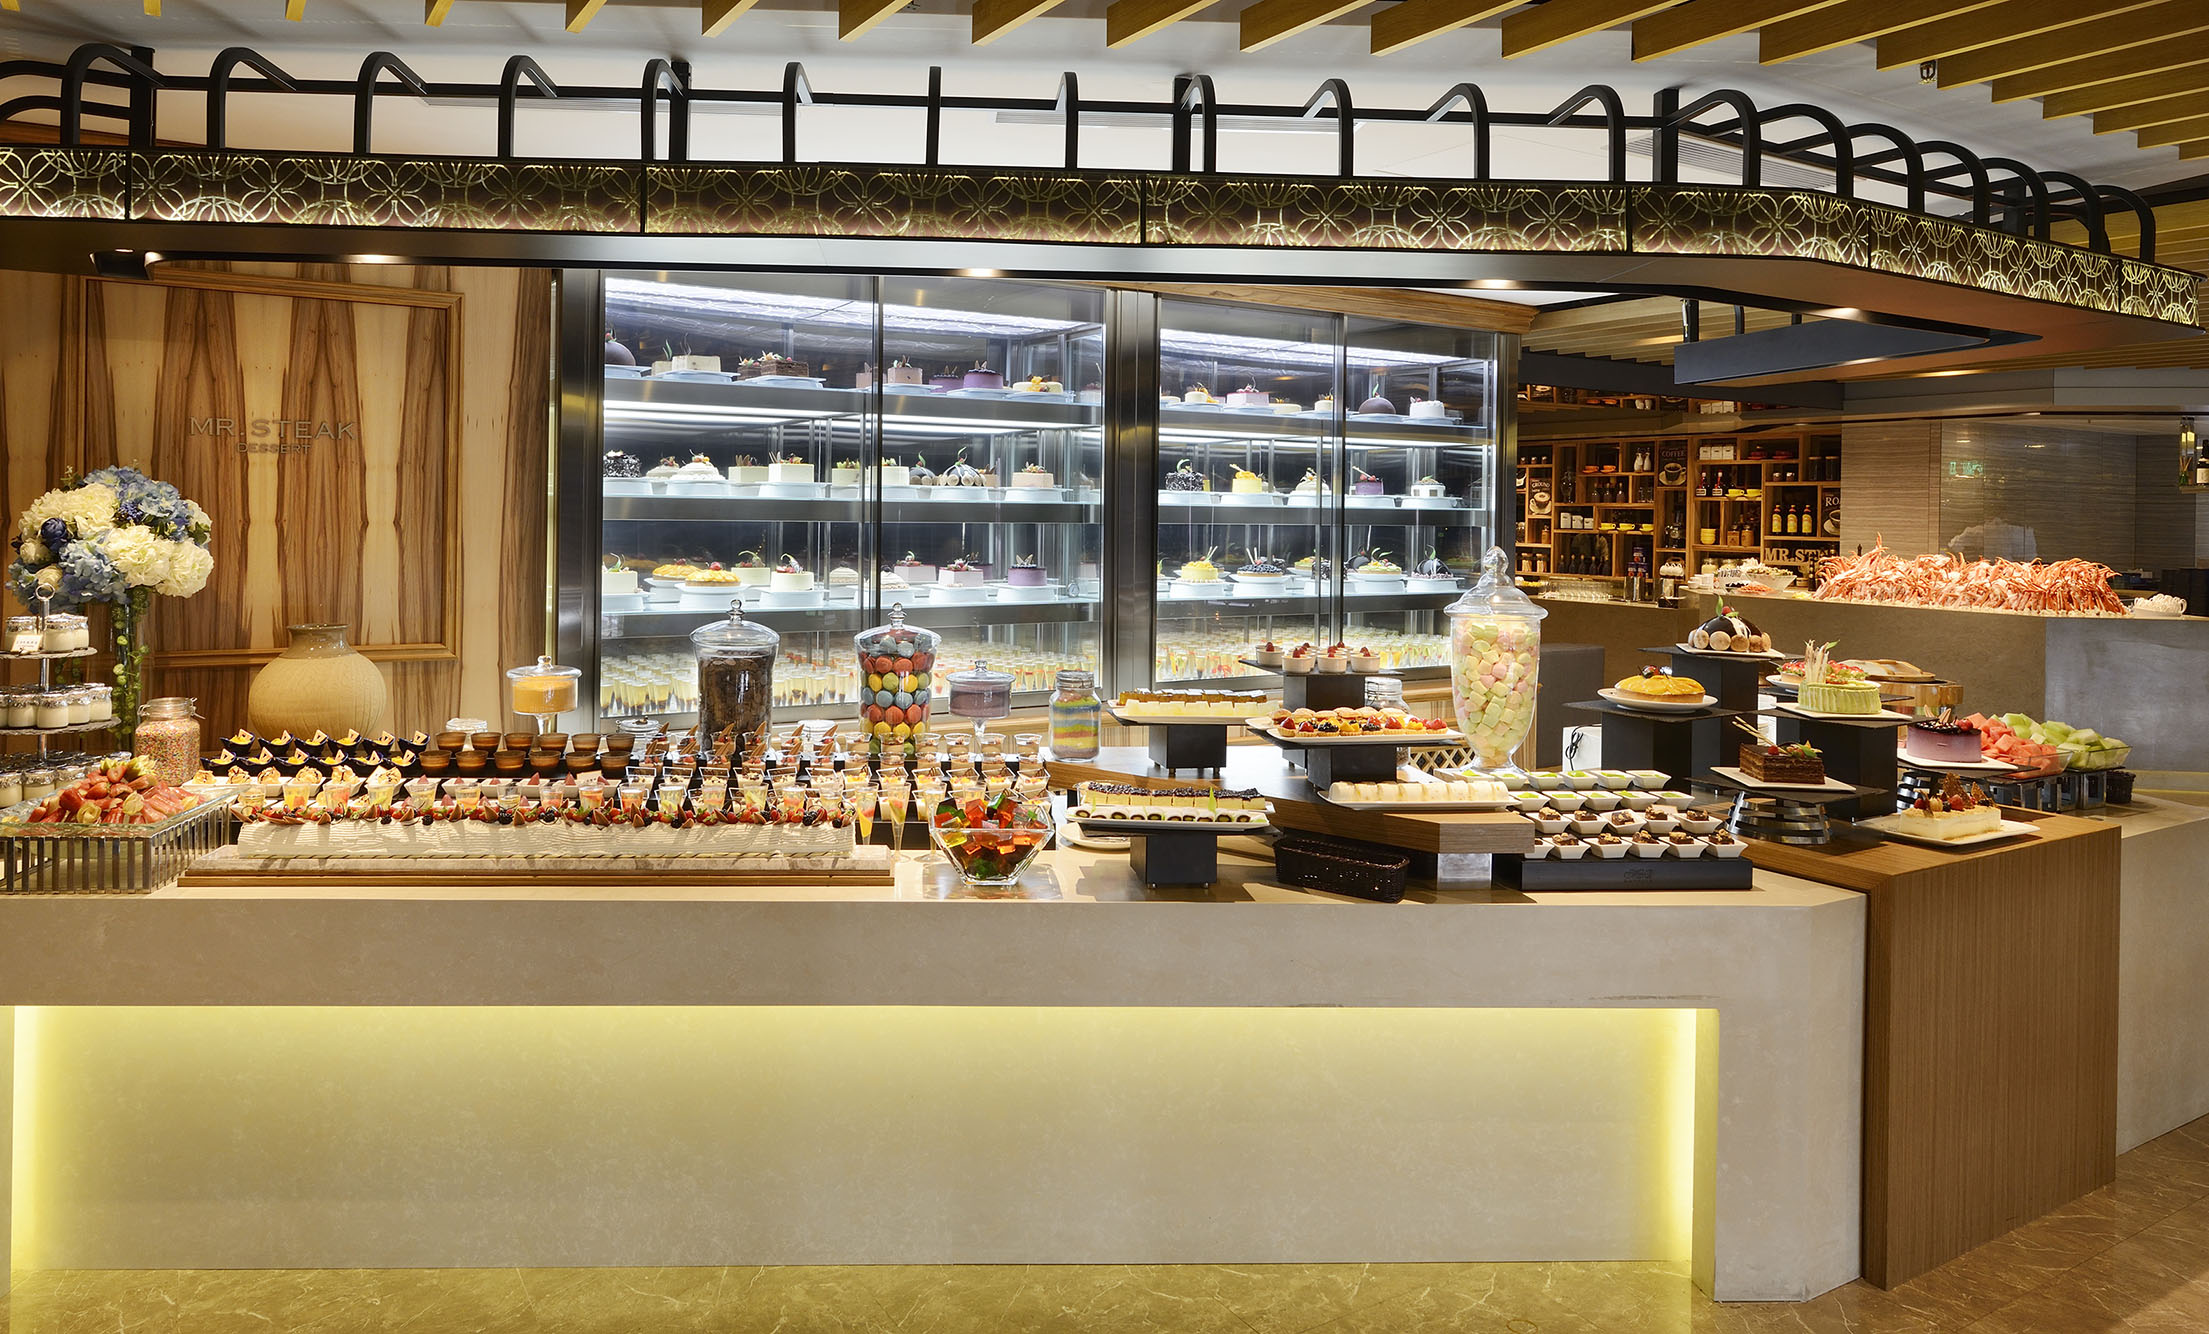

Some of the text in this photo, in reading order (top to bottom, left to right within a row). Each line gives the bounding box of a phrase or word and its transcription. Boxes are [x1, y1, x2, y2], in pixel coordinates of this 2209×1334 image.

[251, 418, 357, 440] STEAK
[237, 442, 312, 455] DESSERT
[1825, 496, 1841, 507] RO
